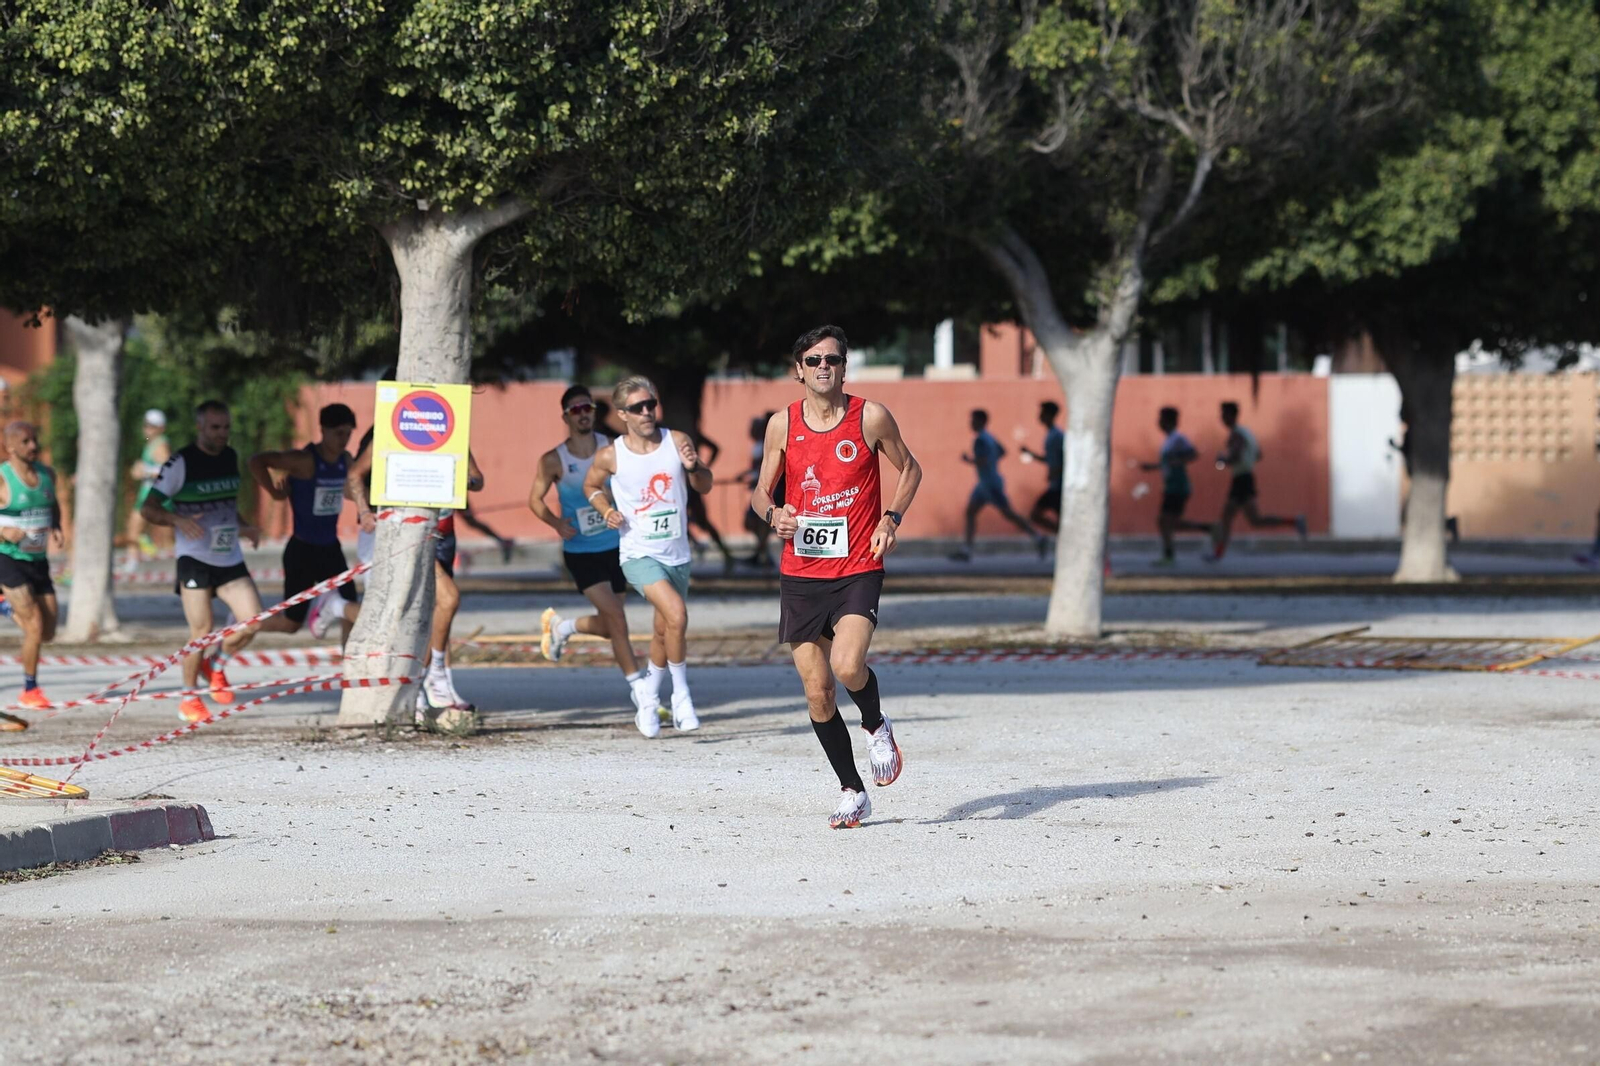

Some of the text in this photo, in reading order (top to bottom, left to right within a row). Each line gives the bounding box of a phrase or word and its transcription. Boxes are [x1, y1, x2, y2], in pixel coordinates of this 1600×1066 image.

[402, 410, 444, 420] PROHIBIDO
[399, 422, 446, 432] ESTACIONAR
[811, 486, 860, 507] CORREDORES
[819, 497, 854, 513] CON MIGA
[652, 517, 669, 532] 14
[803, 527, 839, 546] 661
